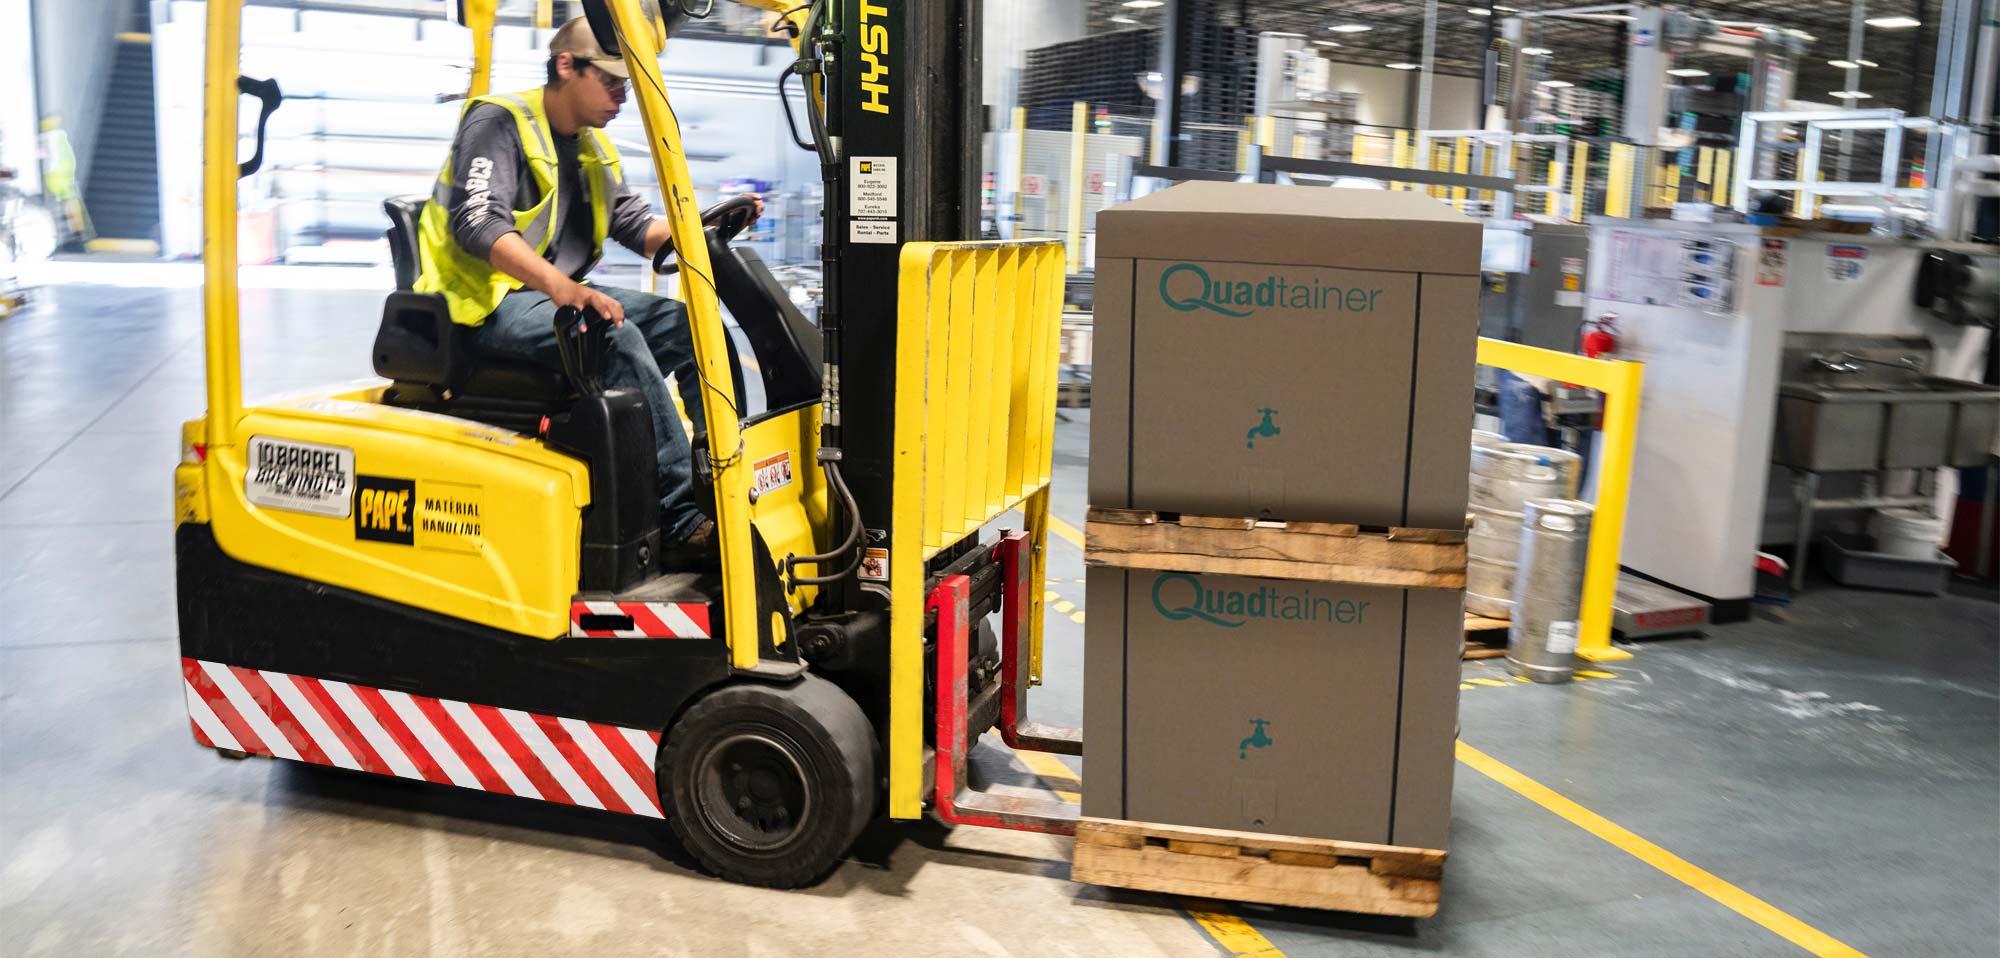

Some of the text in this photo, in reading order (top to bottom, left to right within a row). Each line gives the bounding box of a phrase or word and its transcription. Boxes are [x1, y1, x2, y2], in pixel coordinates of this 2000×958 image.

[861, 0, 889, 114] HYST
[1160, 263, 1383, 317] Quadtainer
[422, 518, 481, 536] HANDLING
[1152, 573, 1371, 628] Quadtainer
